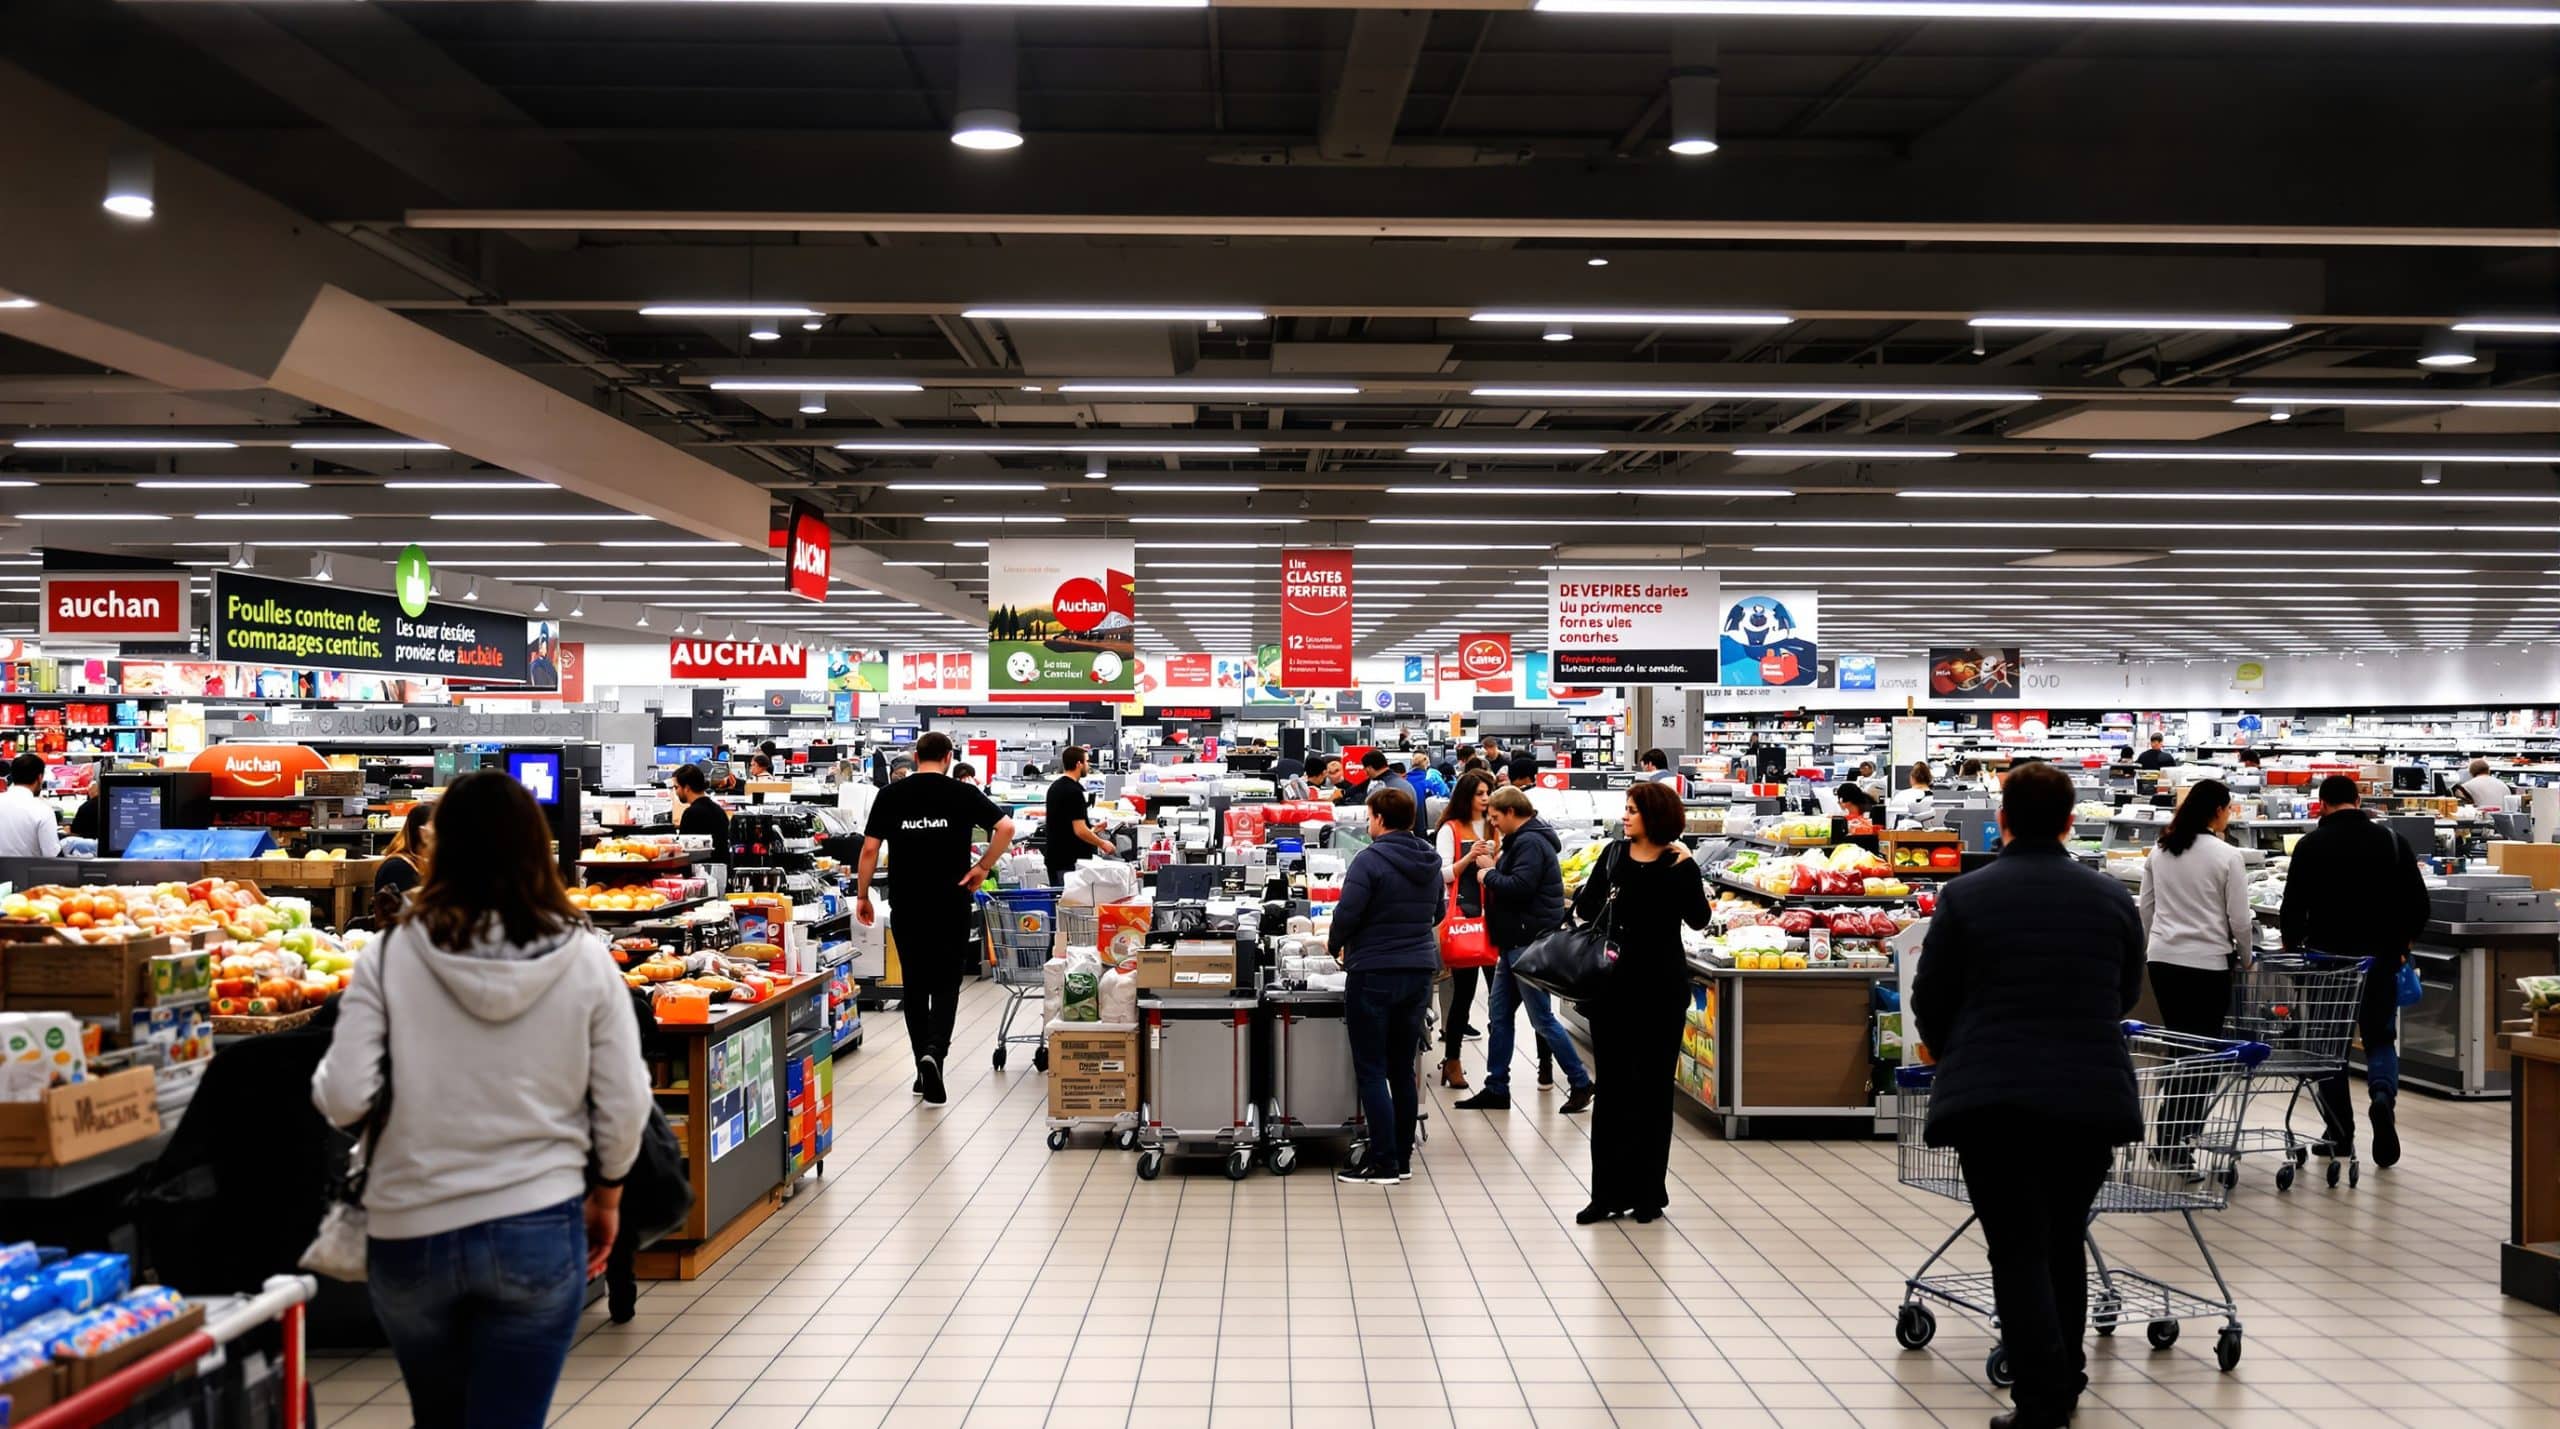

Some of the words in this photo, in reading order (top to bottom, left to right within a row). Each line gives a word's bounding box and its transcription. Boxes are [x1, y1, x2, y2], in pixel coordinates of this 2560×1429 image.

[58, 589, 160, 618] auchan
[1056, 598, 1107, 613] Auchan
[1288, 635, 1304, 649] 12
[671, 642, 801, 666] AUCHAN
[225, 755, 281, 772] Auchan
